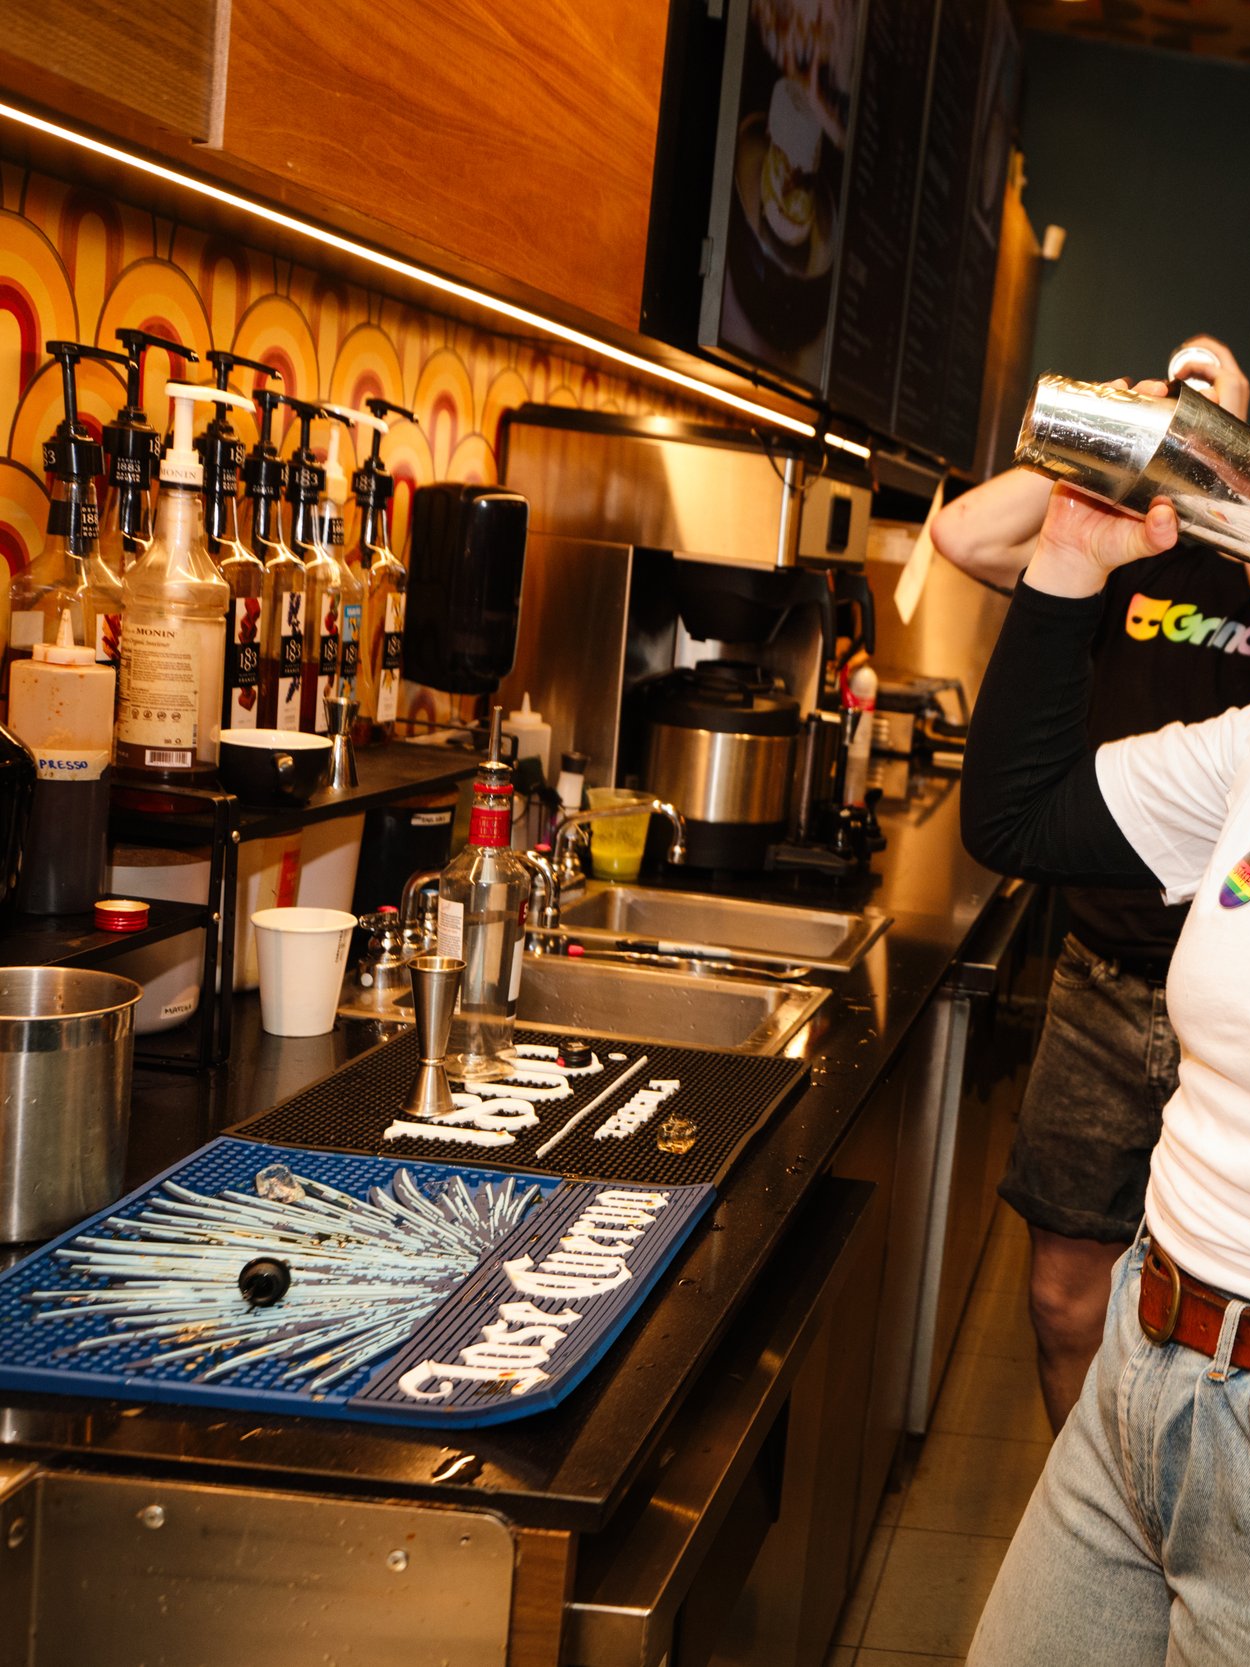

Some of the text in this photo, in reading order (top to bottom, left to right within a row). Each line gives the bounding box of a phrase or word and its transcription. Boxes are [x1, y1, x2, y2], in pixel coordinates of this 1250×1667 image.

[160, 467, 198, 480] MONIN
[136, 627, 175, 638] MONIN
[240, 647, 257, 672] 1883
[285, 639, 301, 663] 1883
[39, 759, 88, 770] PRESSO
[383, 1043, 604, 1147] 1800
[593, 1079, 681, 1141] TEQUILA
[502, 1189, 670, 1300] Cuervo
